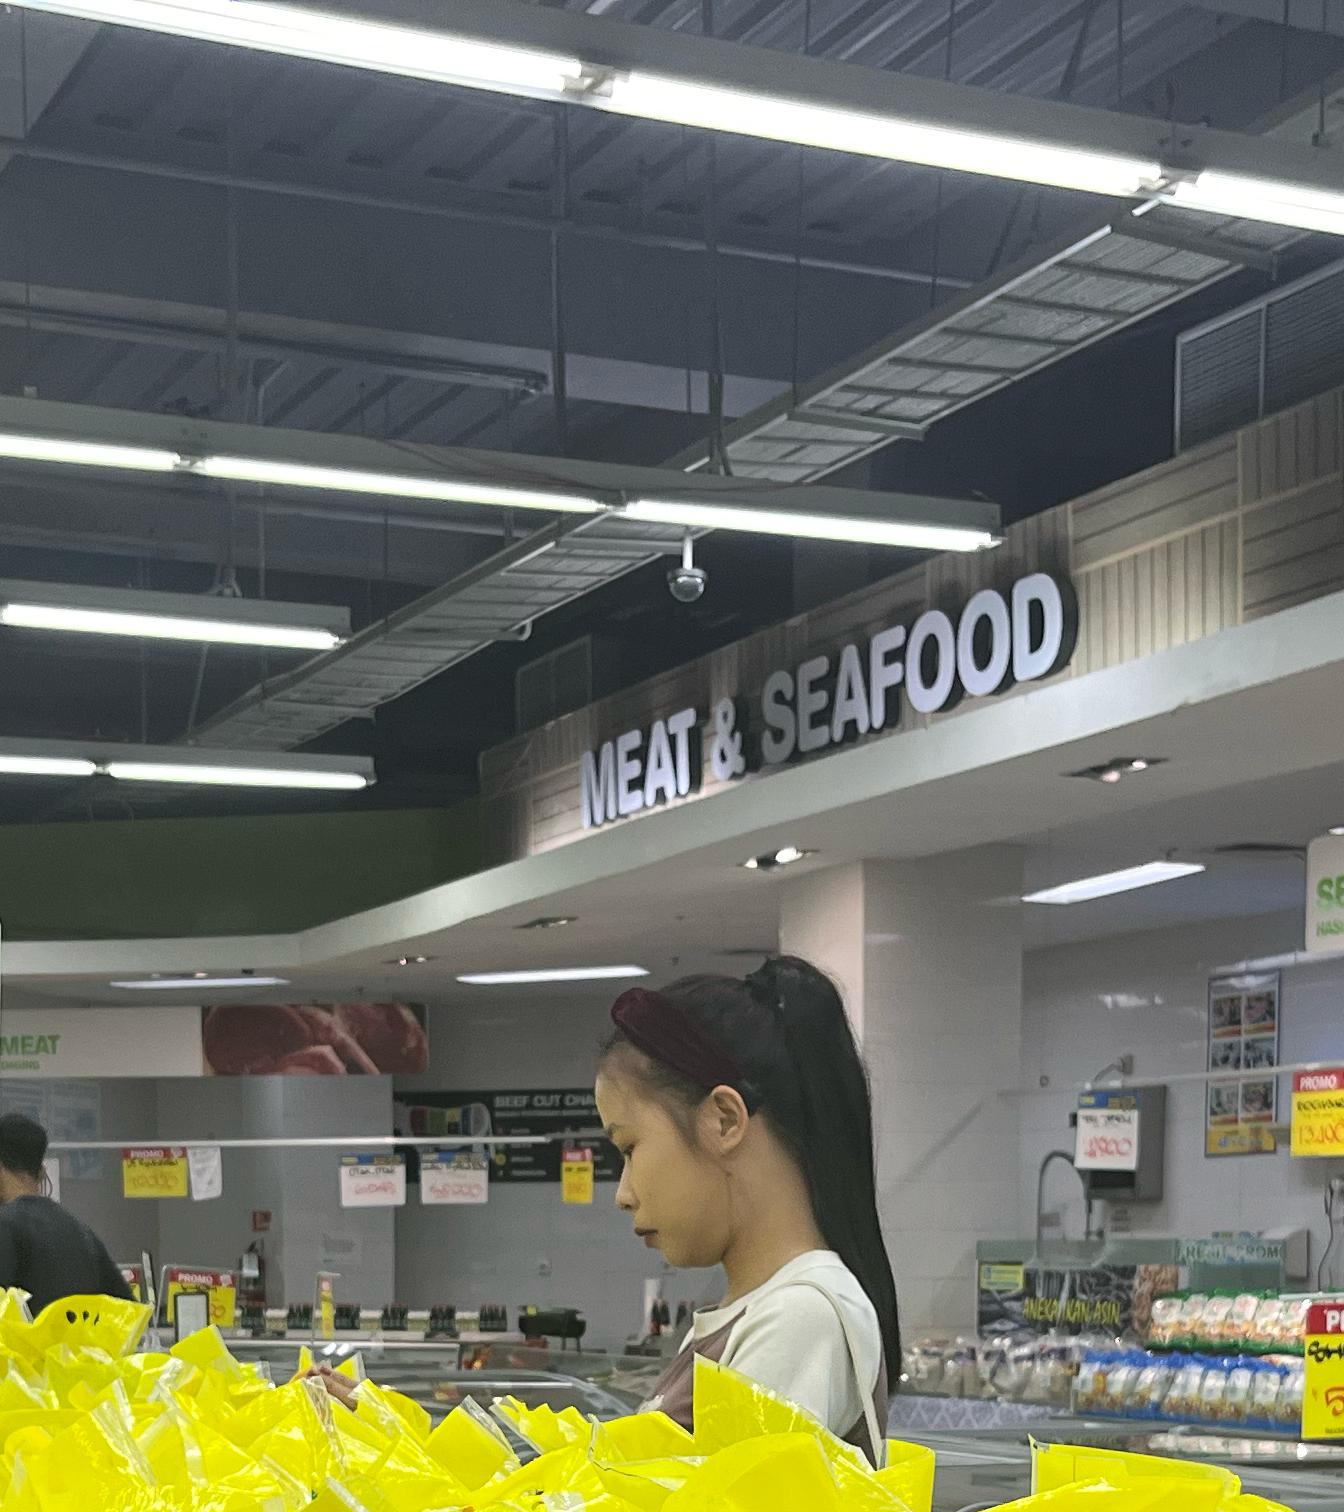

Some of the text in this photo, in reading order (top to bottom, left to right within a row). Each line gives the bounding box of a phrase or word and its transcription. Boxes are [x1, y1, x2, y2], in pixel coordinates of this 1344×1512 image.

[580, 572, 1068, 828] MEAT & SEAFOOD
[0, 1034, 61, 1055] MEAT
[1299, 1074, 1337, 1090] PROMO
[494, 1095, 529, 1106] BEEF
[533, 1094, 561, 1106] CUT
[1024, 1298, 1057, 1321] ANEKA
[1091, 1299, 1120, 1326] ASIN
